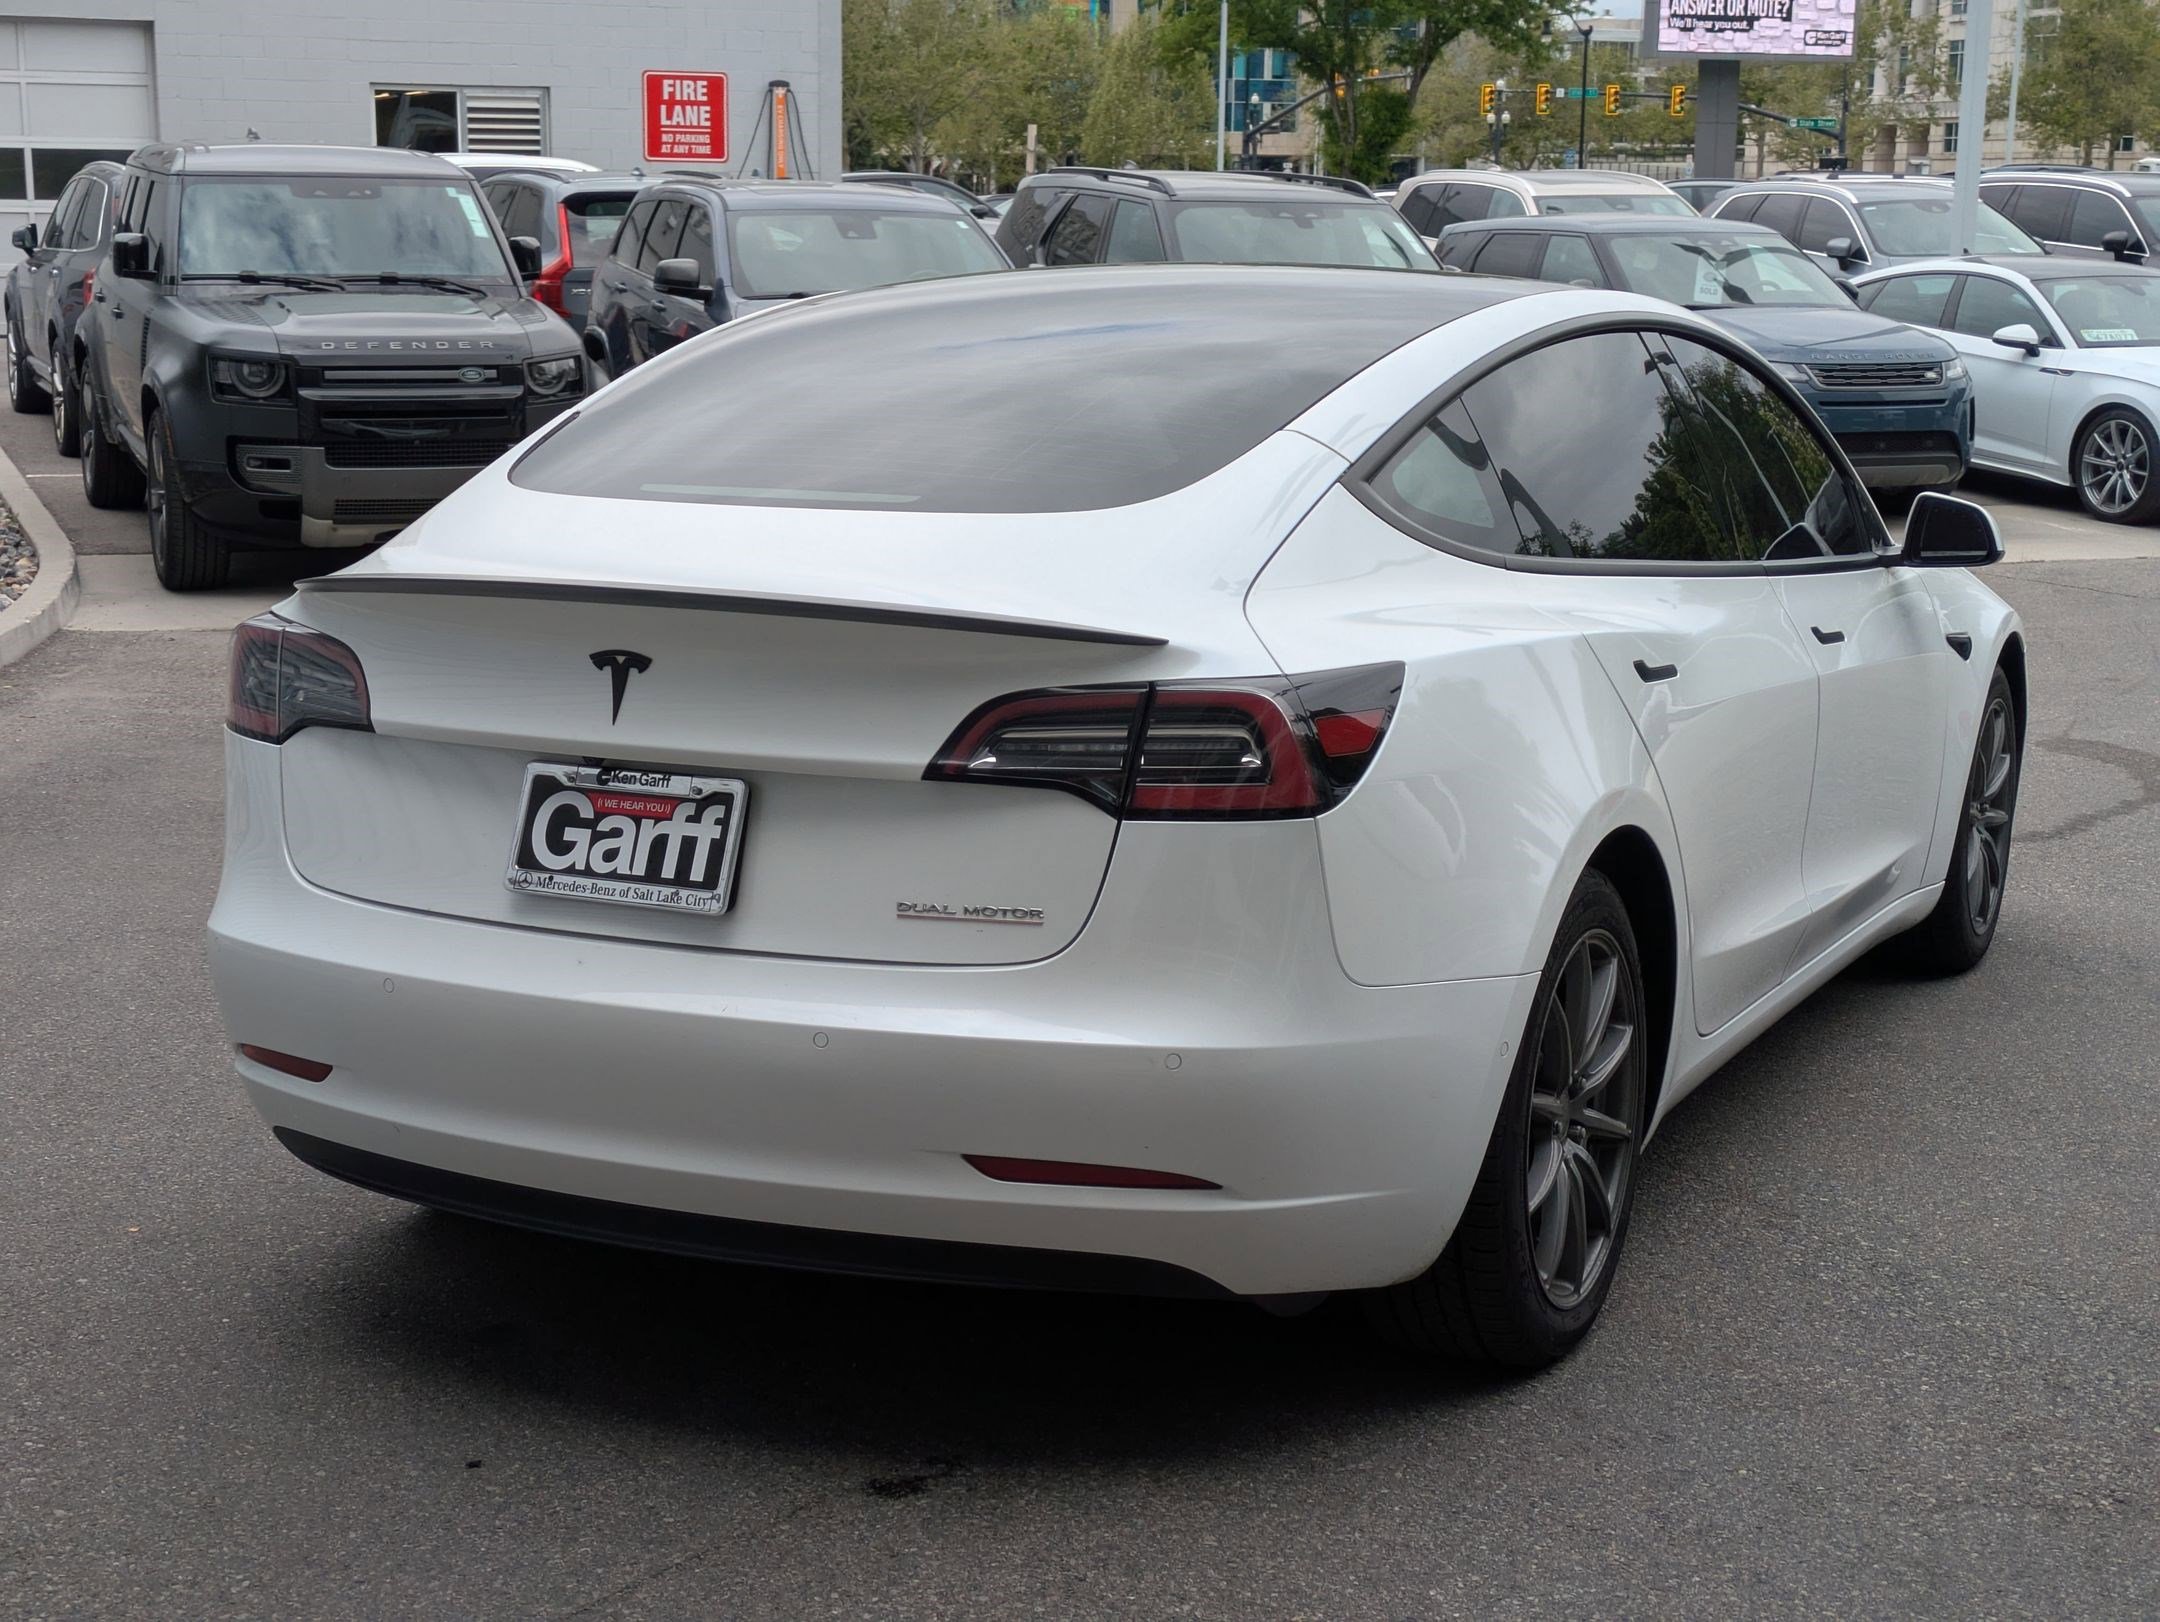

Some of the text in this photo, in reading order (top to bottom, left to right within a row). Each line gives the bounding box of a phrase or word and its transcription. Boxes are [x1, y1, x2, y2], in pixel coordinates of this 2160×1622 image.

[1671, 0, 1790, 18] ANSWER OR MUTE?
[1669, 18, 1692, 28] We'll
[1693, 19, 1713, 29] hear
[1714, 21, 1731, 31] you
[662, 79, 708, 101] FIRE
[660, 104, 711, 127] LANE
[661, 133, 711, 144] NO PARKING
[661, 144, 711, 155] AT ANY TIME
[321, 341, 495, 350] DEFENDER
[1807, 352, 1936, 360] RANGE ROVER
[611, 770, 672, 788] Ken Garff
[605, 799, 665, 812] WE HEAR YOU
[531, 790, 725, 882] Garff
[535, 876, 709, 908] Mercedes-Benz of Salt Lake City
[896, 901, 1044, 919] DUAL MOTOR
